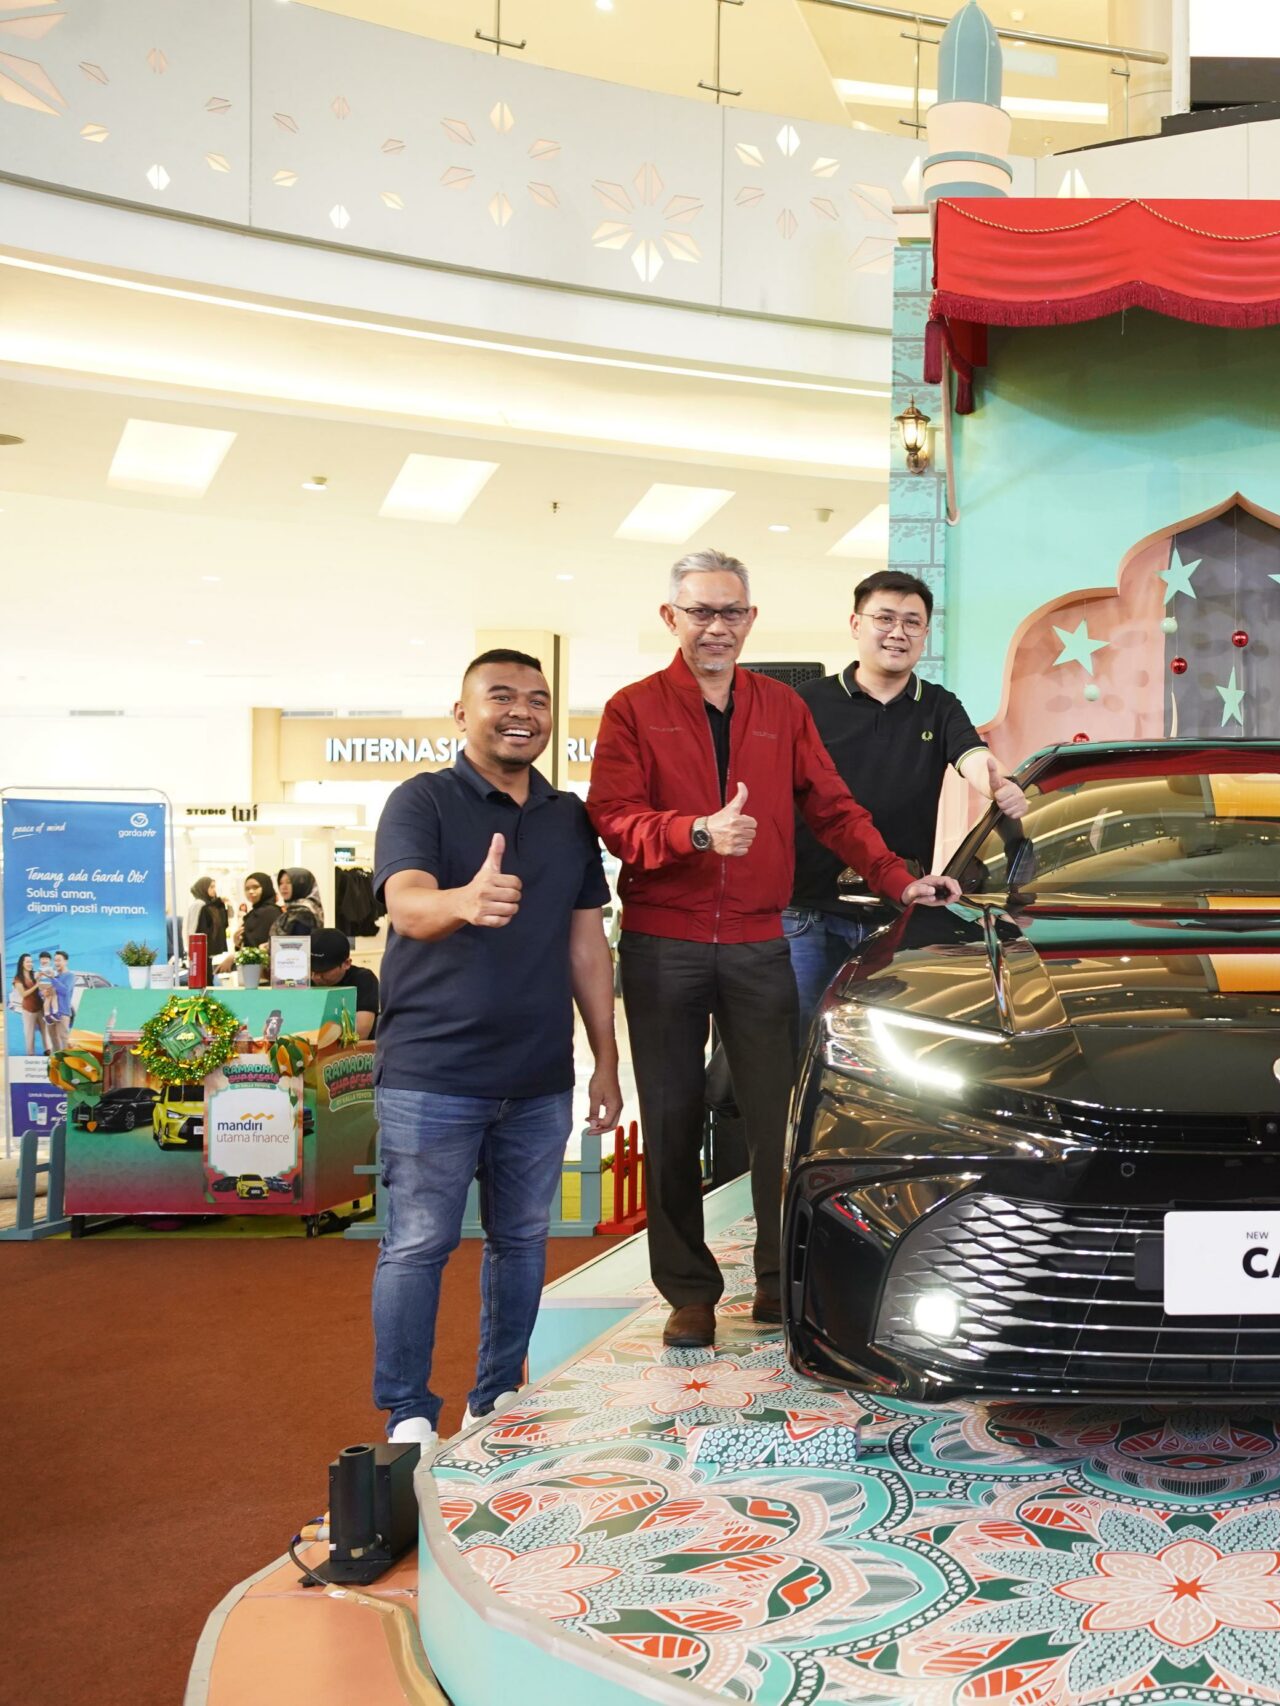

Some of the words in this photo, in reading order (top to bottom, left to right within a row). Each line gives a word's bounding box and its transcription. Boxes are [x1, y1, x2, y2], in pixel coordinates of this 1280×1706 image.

[325, 737, 467, 763] INTERNASI
[12, 825, 34, 837] peace
[35, 822, 45, 834] of
[47, 822, 66, 832] mind
[68, 869, 88, 882] ada
[92, 869, 124, 883] Garda
[127, 869, 149, 884] Oto!
[26, 888, 58, 898] Solusi
[61, 890, 97, 900] aman,
[27, 902, 67, 914] dijamin
[71, 903, 98, 915] pasti
[101, 905, 149, 916] nyaman.
[323, 1053, 374, 1083] RAMADH
[217, 1120, 262, 1131] mandiri
[216, 1132, 250, 1143] utama
[252, 1132, 290, 1143] finance
[1246, 1231, 1269, 1240] NEW
